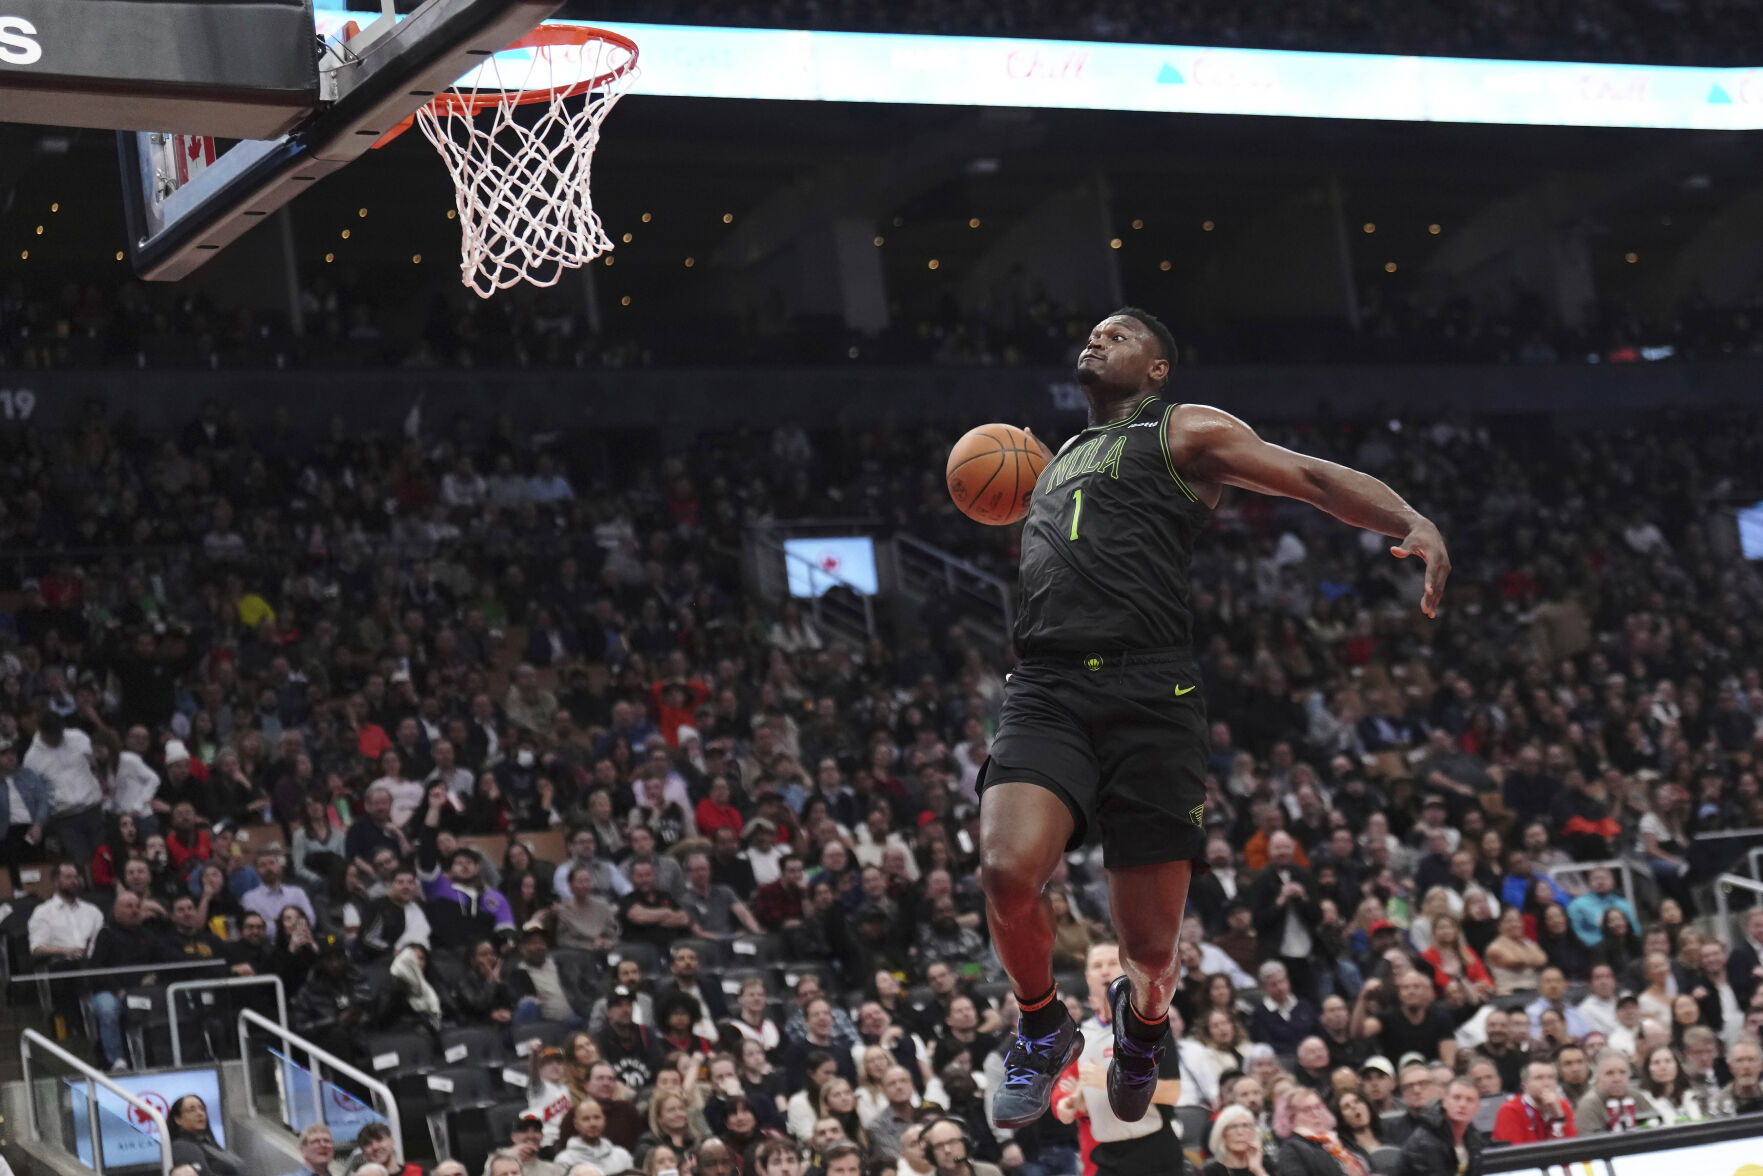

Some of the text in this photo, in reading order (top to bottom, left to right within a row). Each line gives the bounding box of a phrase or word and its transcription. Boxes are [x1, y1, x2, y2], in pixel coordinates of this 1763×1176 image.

[0, 16, 42, 65] S
[1046, 434, 1127, 495] NOLA
[1070, 489, 1082, 541] 1
